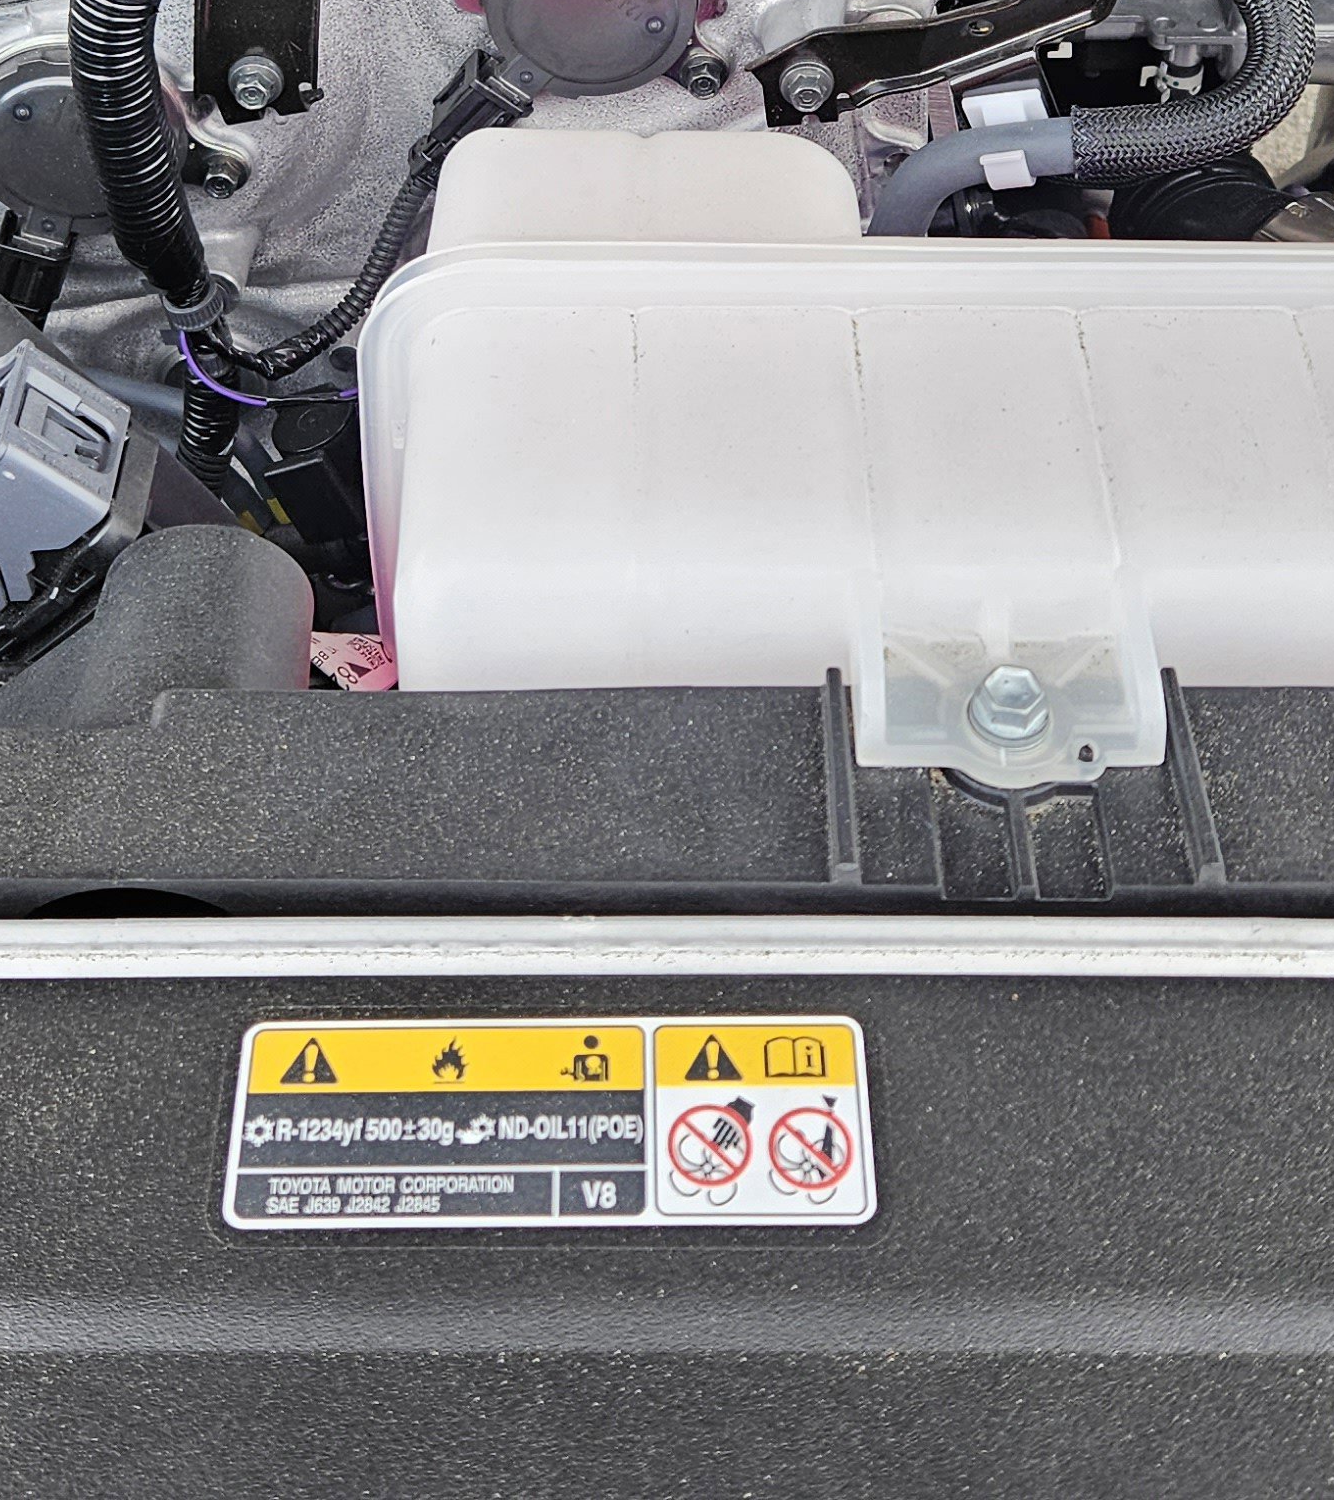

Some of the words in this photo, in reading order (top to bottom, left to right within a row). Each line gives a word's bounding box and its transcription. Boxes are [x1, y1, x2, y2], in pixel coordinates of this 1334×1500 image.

[275, 1116, 364, 1147] R-1234yf
[364, 1116, 456, 1146] 500±30g
[498, 1114, 645, 1145] ND-OIL11(POE)
[269, 1176, 332, 1196] TOYOTA
[335, 1176, 396, 1195] MOTOR
[399, 1174, 515, 1194] CORPORATION
[580, 1180, 618, 1210] V8
[266, 1197, 300, 1214] SAE
[303, 1197, 342, 1214] J639
[344, 1196, 391, 1214] J2842
[393, 1195, 441, 1213] J2845
